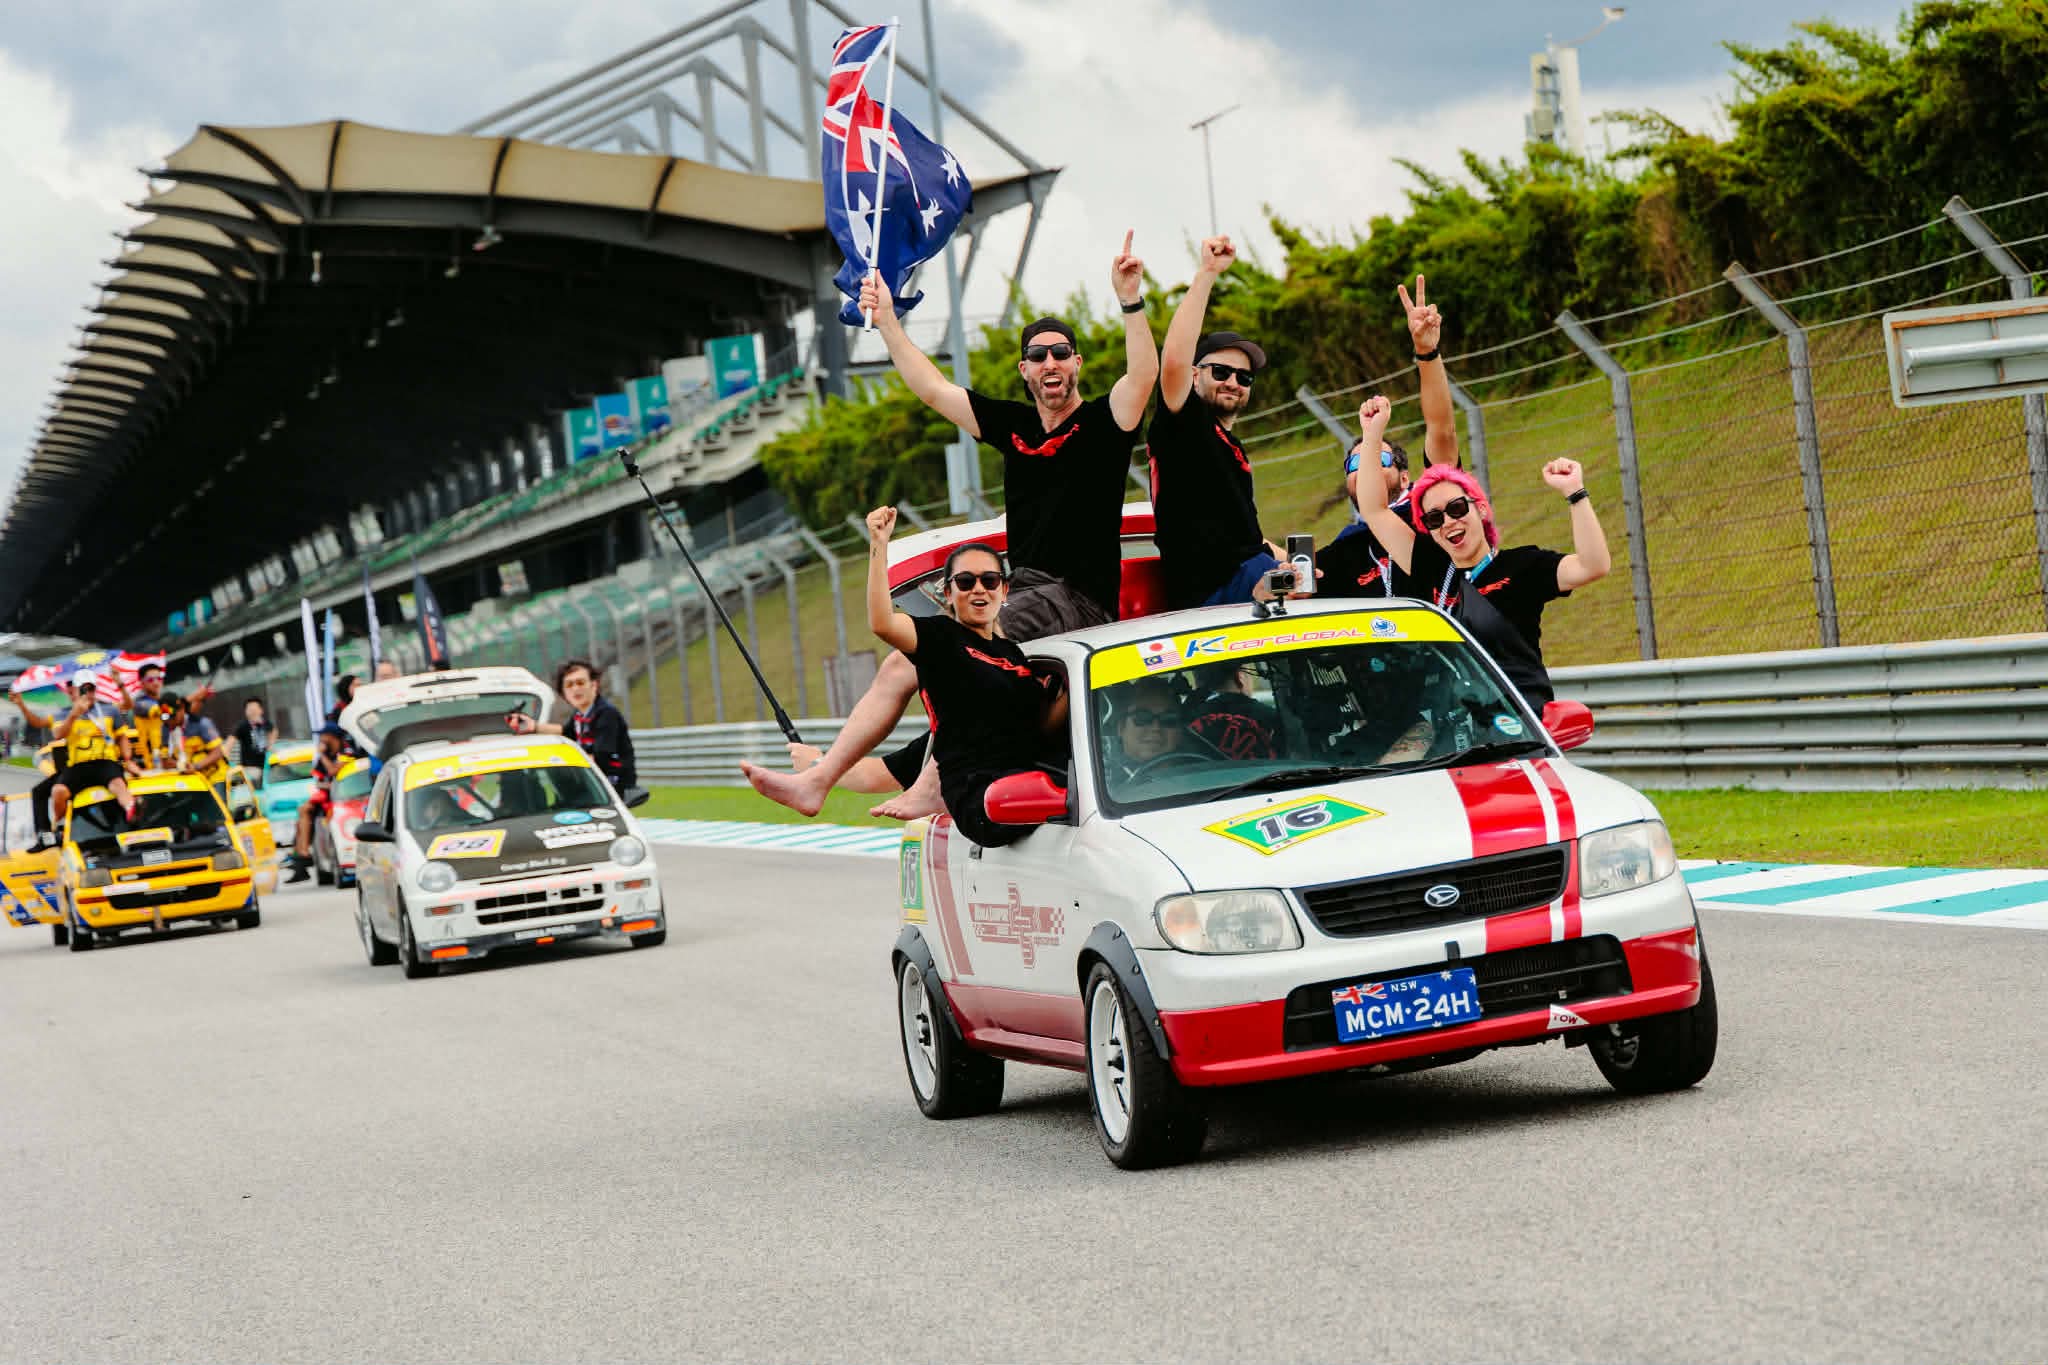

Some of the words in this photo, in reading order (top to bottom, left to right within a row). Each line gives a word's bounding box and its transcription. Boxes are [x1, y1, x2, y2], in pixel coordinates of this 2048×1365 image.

[1256, 801, 1333, 844] 16
[1390, 980, 1417, 993] NSW
[1552, 1012, 1578, 1024] TOW
